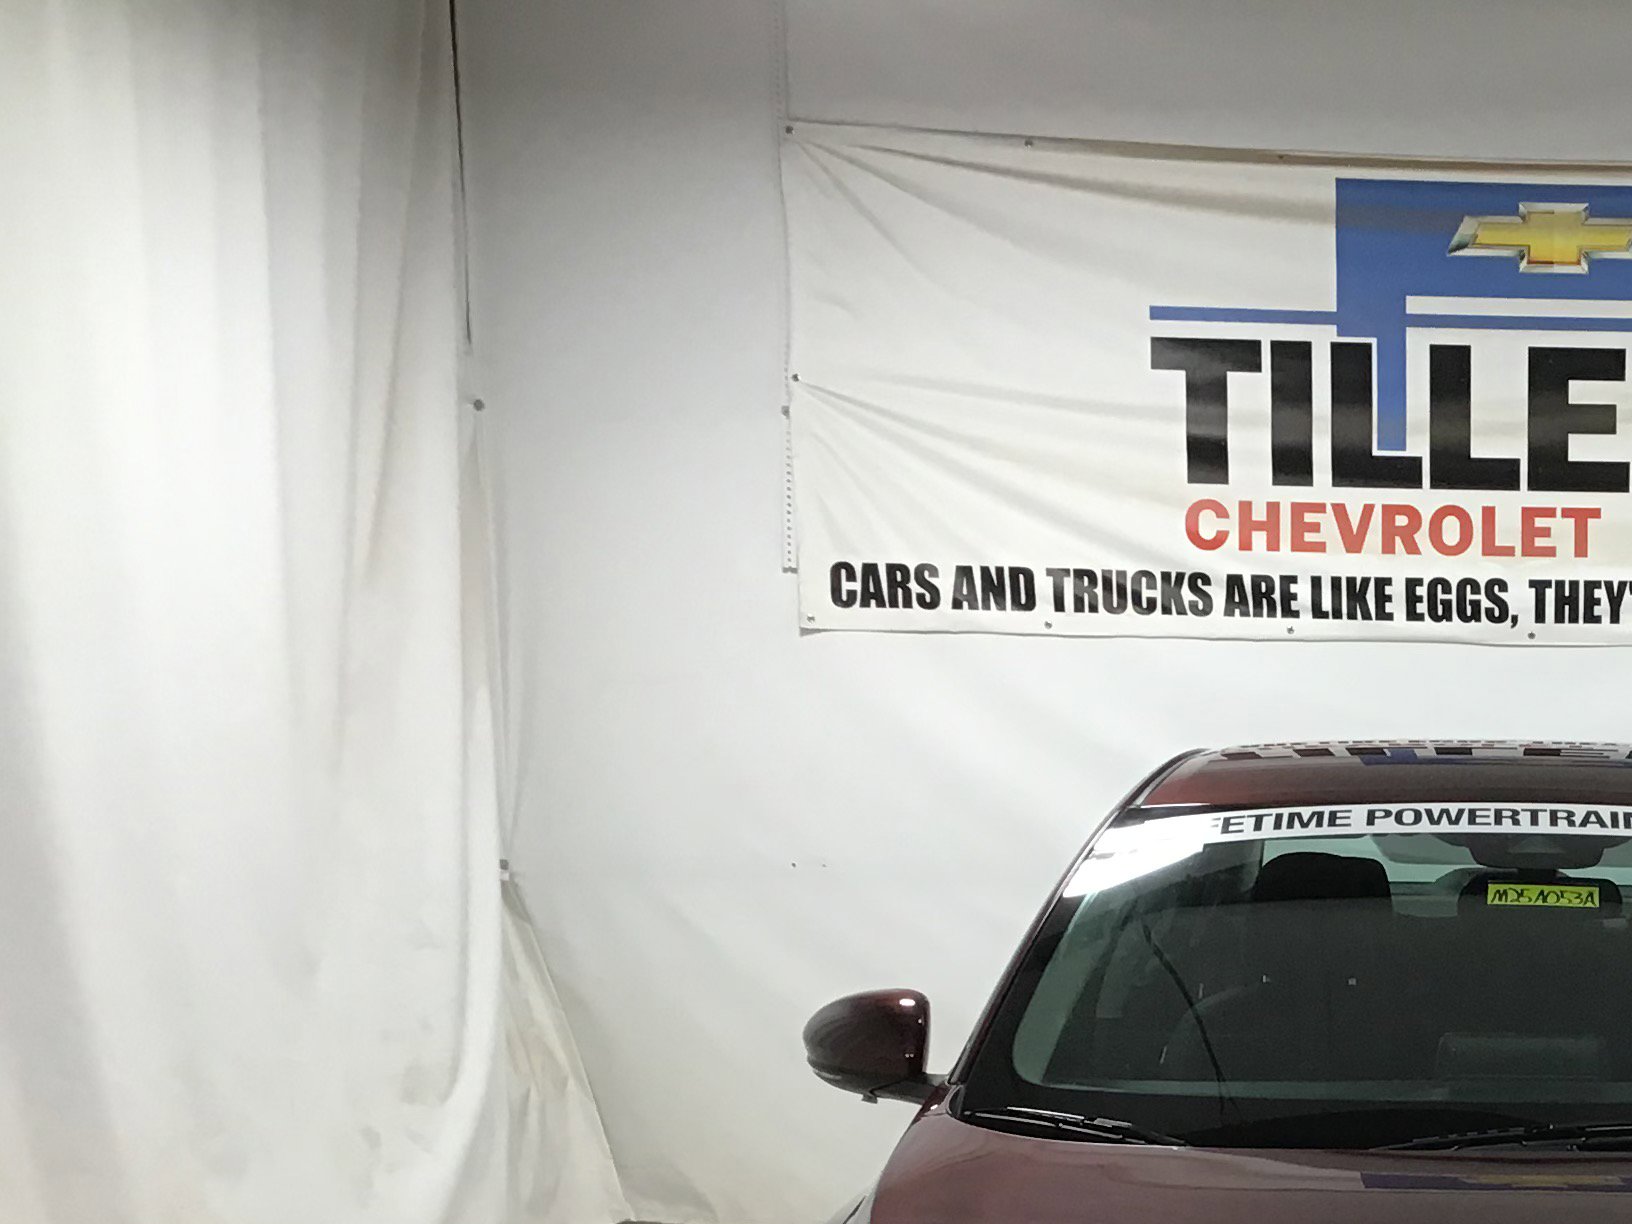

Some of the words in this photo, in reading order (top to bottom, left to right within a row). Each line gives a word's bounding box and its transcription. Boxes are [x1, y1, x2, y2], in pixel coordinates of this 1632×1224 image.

[1184, 498, 1602, 558] CHEVROLET
[828, 560, 940, 610] CARS
[951, 564, 1036, 614] AND
[1045, 567, 1213, 618] TRUCKS
[1222, 573, 1301, 619] ARE
[1309, 575, 1395, 622] LIKE
[1404, 577, 1520, 629] EGGS,
